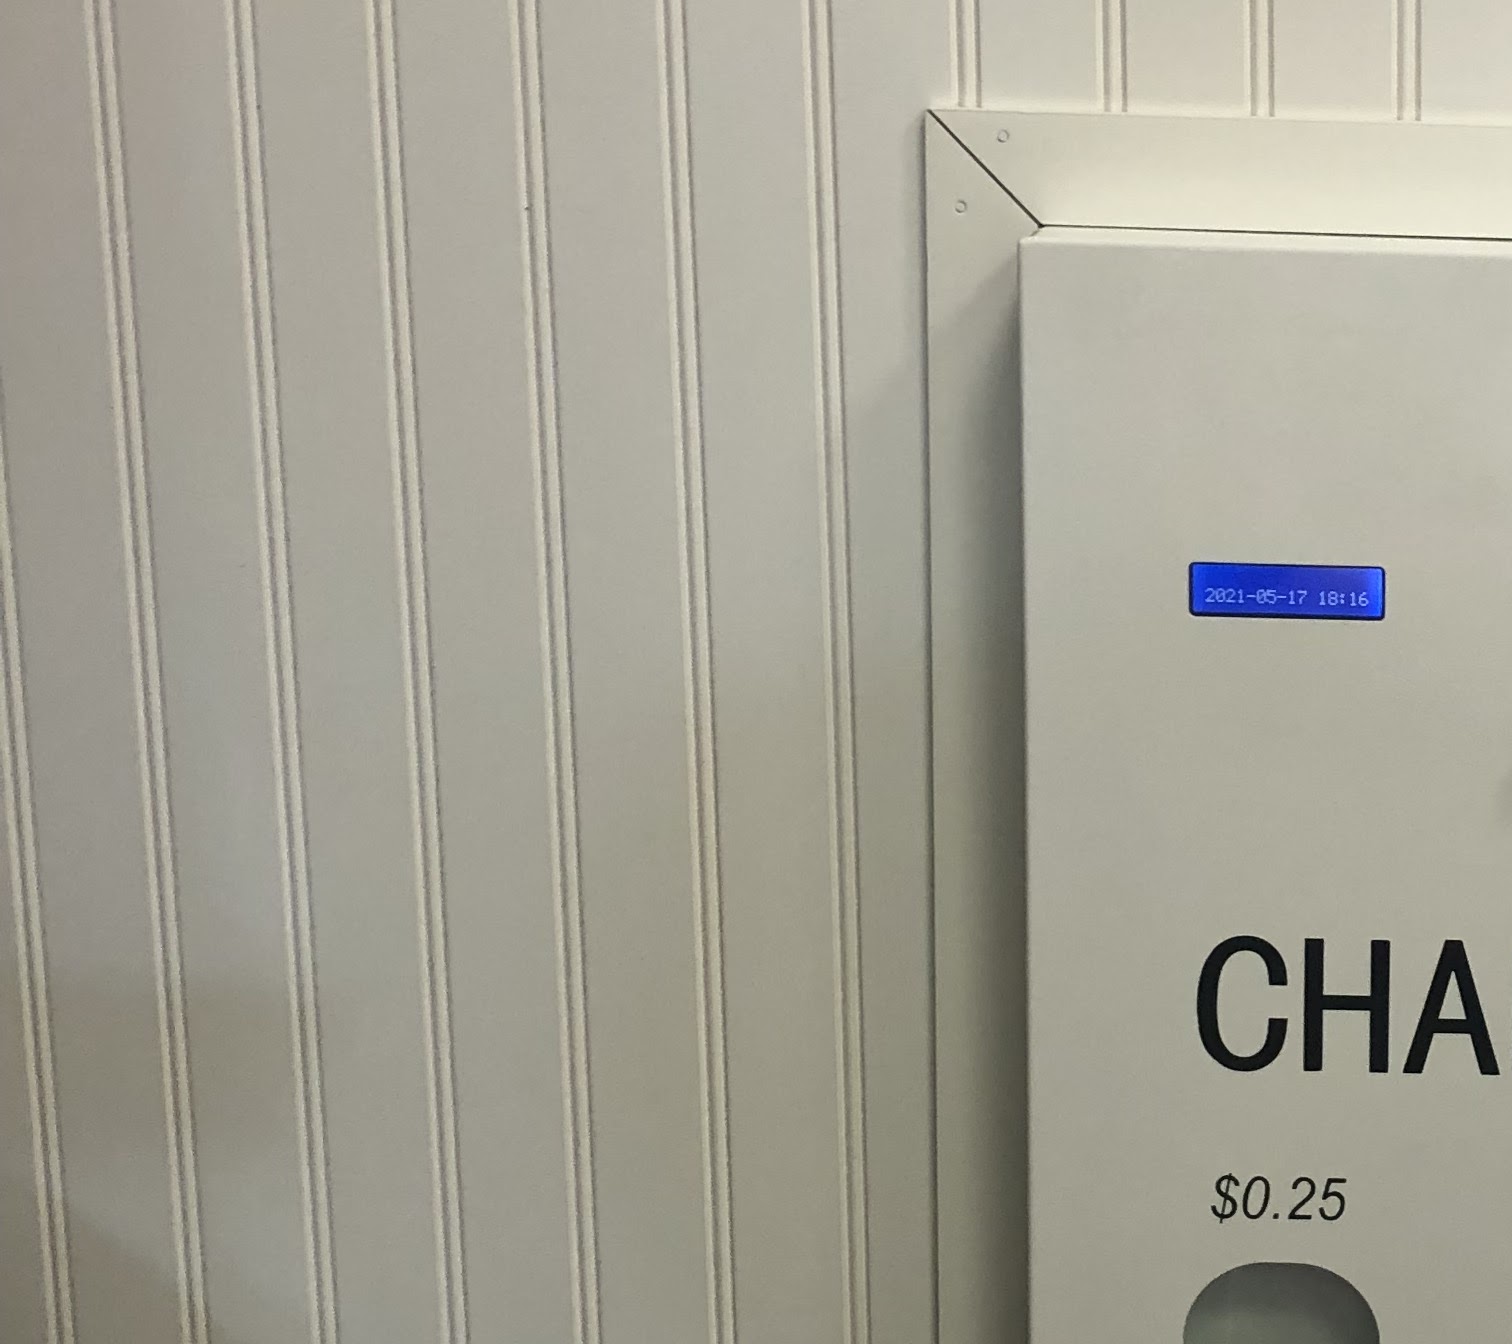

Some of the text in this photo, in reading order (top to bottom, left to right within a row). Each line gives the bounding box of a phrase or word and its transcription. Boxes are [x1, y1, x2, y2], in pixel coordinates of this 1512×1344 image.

[1204, 588, 1369, 607] 2021-05-17 18:16
[1211, 1172, 1347, 1223] $0.25
